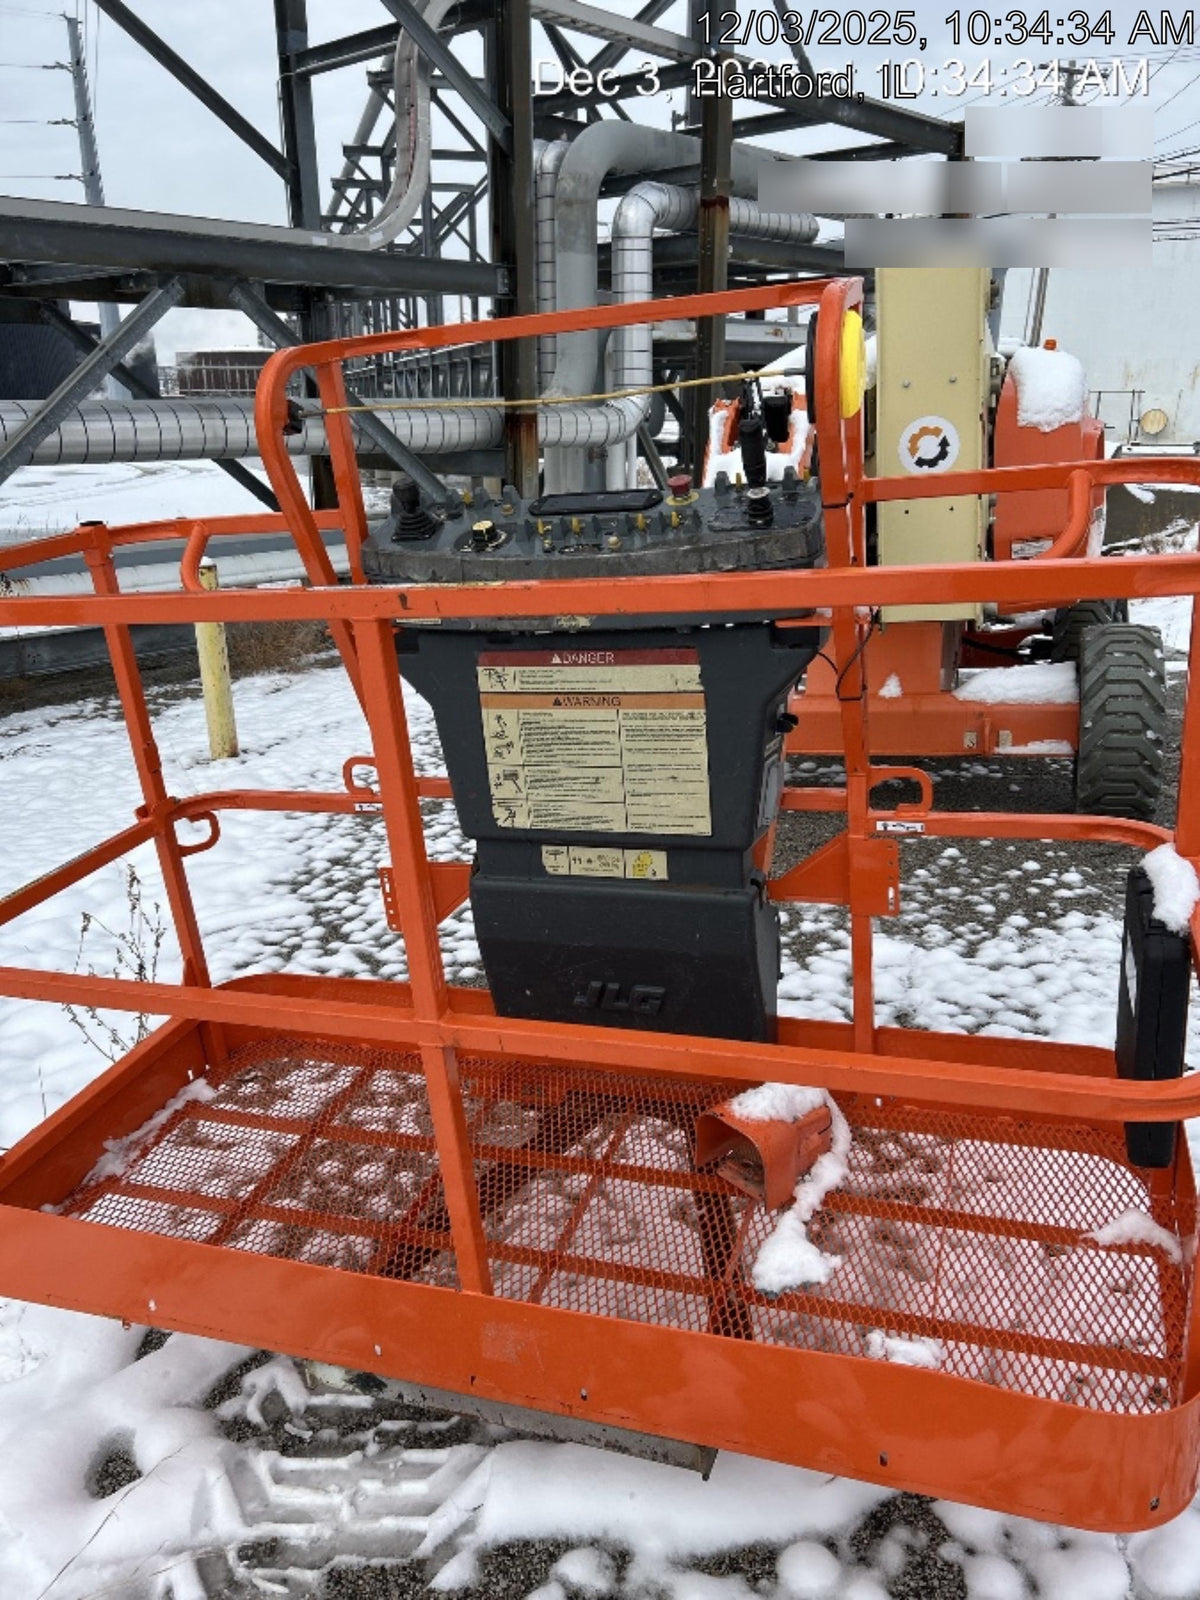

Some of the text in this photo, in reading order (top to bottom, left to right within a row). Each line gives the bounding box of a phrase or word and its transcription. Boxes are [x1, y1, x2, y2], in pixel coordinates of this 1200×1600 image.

[563, 652, 615, 665] DANGER
[563, 696, 621, 707] WARNING
[574, 981, 666, 1014] JLG
